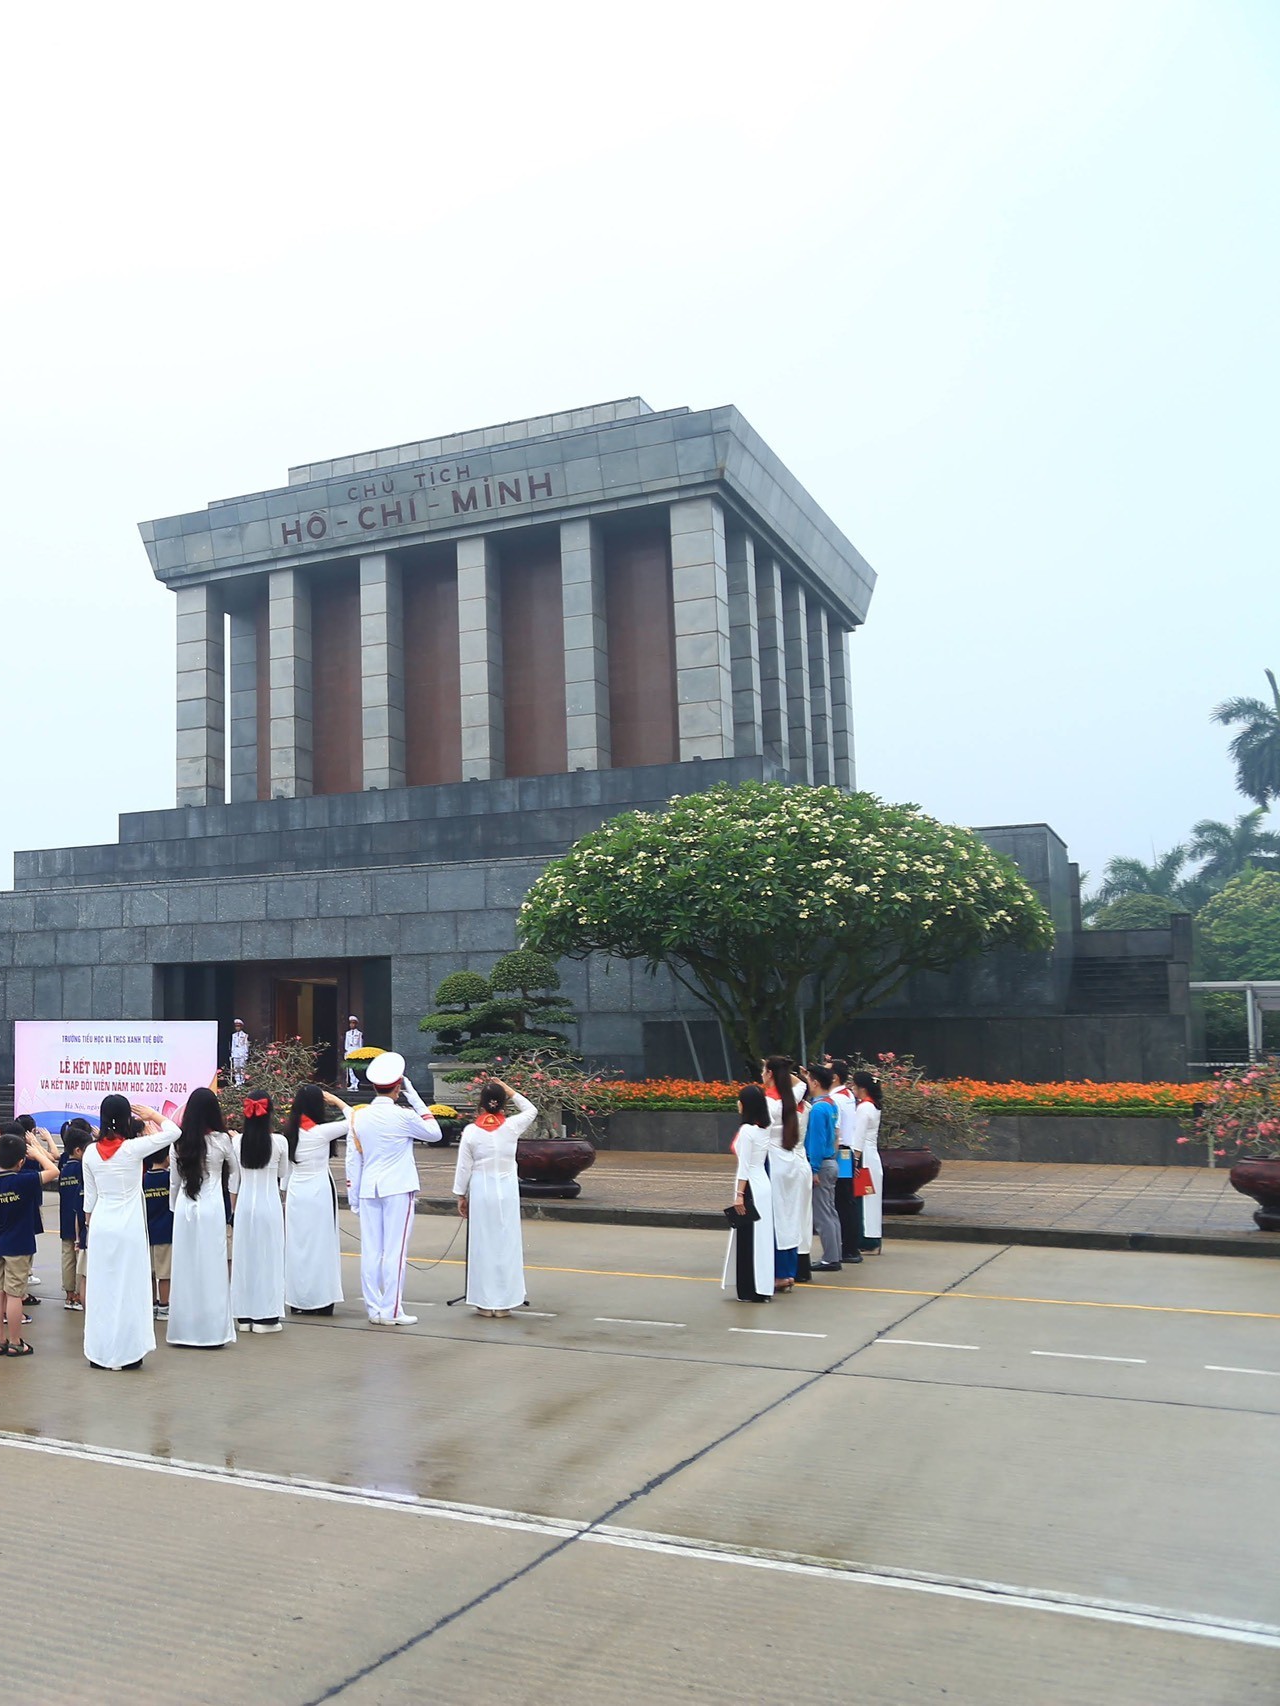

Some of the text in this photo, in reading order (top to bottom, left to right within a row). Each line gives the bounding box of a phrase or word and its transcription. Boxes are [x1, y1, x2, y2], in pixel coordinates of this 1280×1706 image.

[347, 465, 470, 500] CHỦ TỊCH
[281, 509, 327, 545] HỒ
[357, 491, 416, 530] CHÍ
[59, 1055, 167, 1077] LỄ KẾT NẠP ĐOÀN VIÊN
[51, 1076, 64, 1090] KẾT
[65, 1080, 79, 1092] NẠP
[93, 1079, 110, 1091] VIÊN
[146, 1083, 163, 1092] 2023
[169, 1083, 187, 1093] 2024
